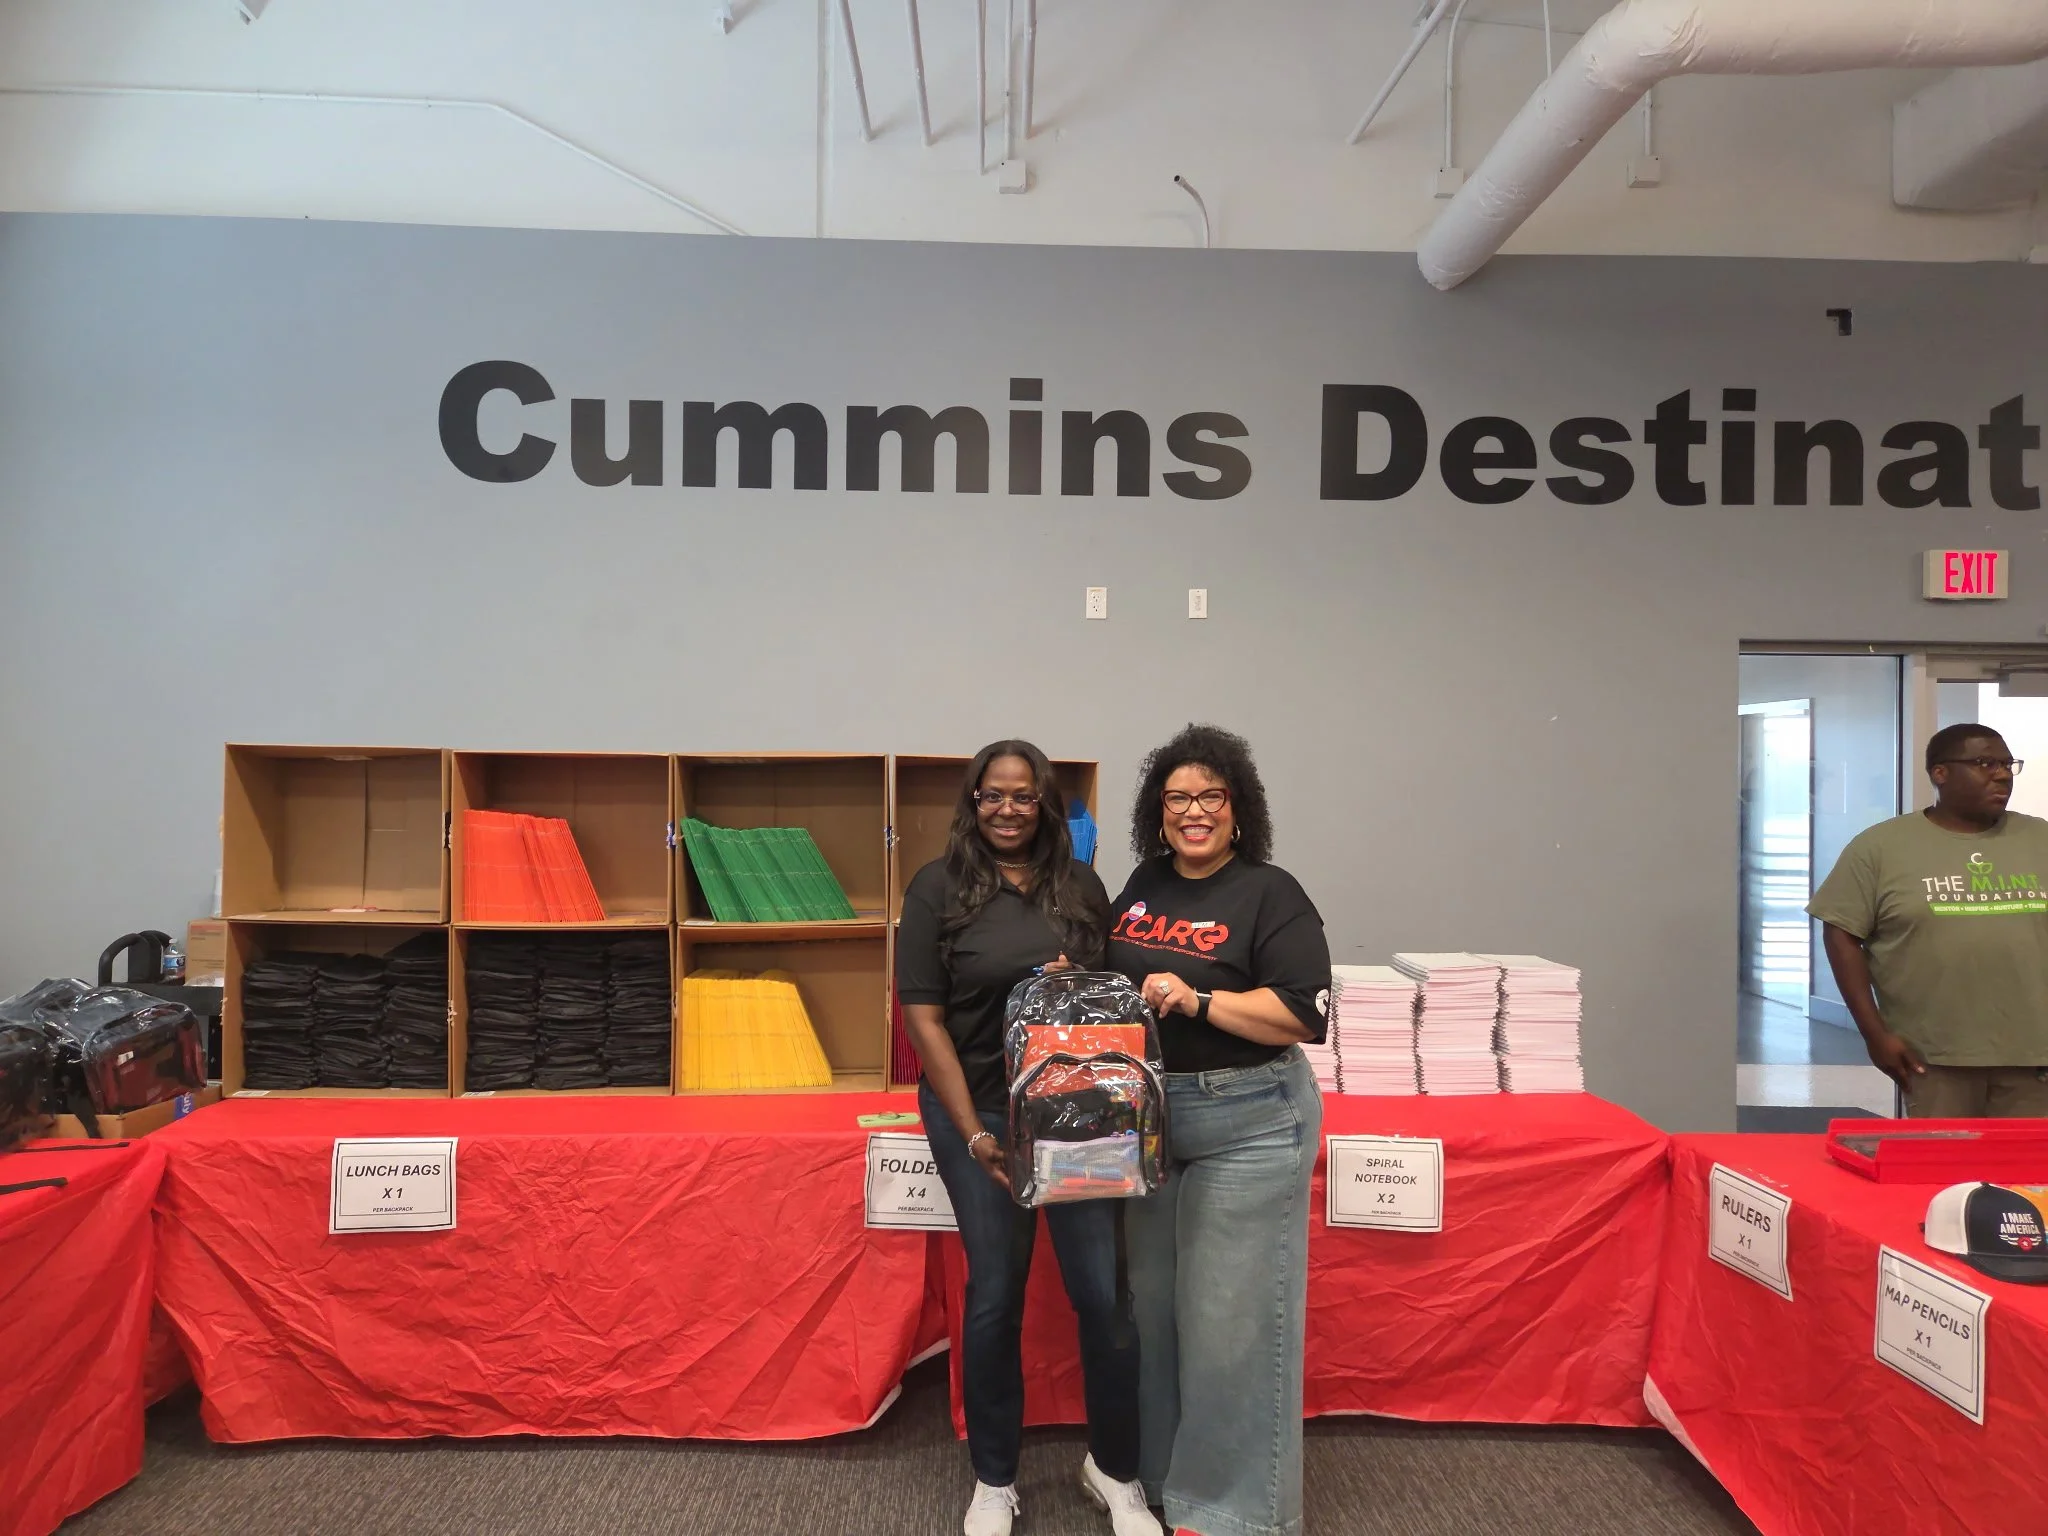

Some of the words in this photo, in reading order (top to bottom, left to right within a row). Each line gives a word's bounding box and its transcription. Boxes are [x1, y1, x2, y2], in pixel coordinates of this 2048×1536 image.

[438, 360, 1252, 500] Cummins
[1320, 384, 2041, 511] Destinat
[1944, 552, 1998, 594] EXIT
[1922, 875, 1964, 892] THE
[1926, 890, 2048, 902] FOUNDATION
[880, 1158, 940, 1176] FOLDE
[1366, 1158, 1405, 1168] SPIRAL
[346, 1165, 399, 1177] LUNCH
[401, 1164, 441, 1176] BAGS
[1354, 1173, 1418, 1186] NOTEBOOK
[382, 1187, 393, 1199] X
[396, 1187, 403, 1199] 1
[906, 1186, 917, 1198] X
[917, 1187, 927, 1199] 4
[1376, 1192, 1386, 1204] X
[1387, 1193, 1396, 1204] 2
[1721, 1194, 1772, 1233] RULERS
[2002, 1212, 2008, 1223] I
[2008, 1212, 2035, 1224] MAKE
[2000, 1223, 2041, 1235] AMERICA
[1738, 1233, 1746, 1247] X
[1747, 1238, 1752, 1250] 1
[1885, 1284, 1911, 1307] MAP
[1911, 1300, 1971, 1340] PENCILS
[1914, 1329, 1924, 1344] X
[1926, 1336, 1932, 1349] 1
